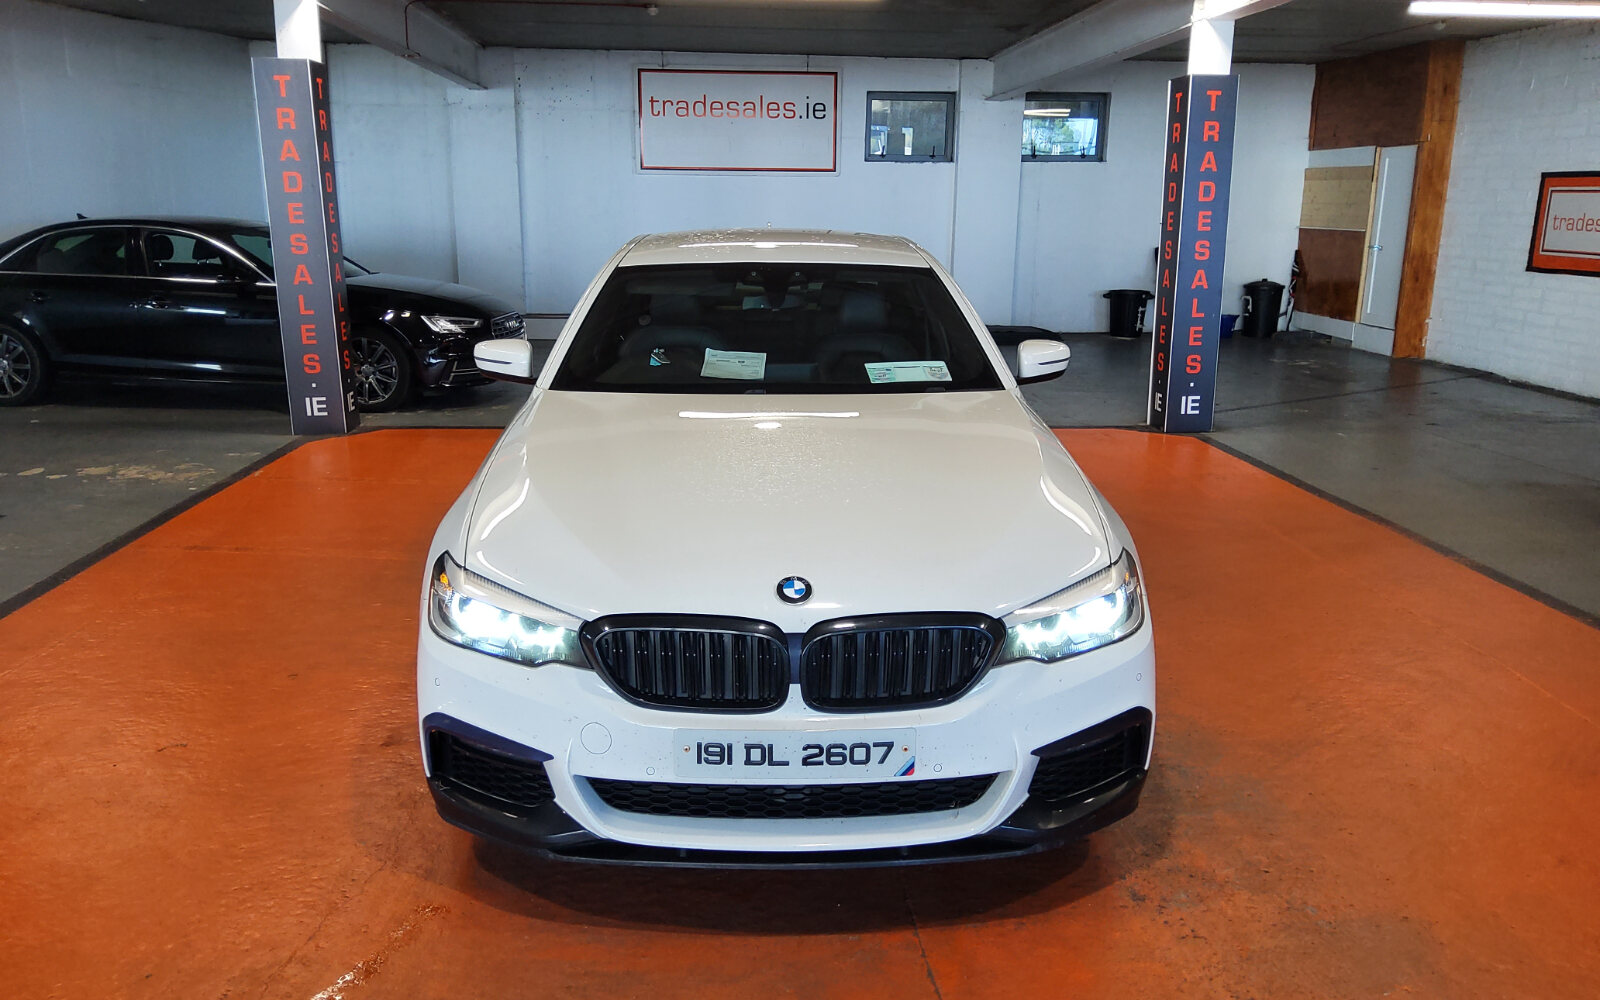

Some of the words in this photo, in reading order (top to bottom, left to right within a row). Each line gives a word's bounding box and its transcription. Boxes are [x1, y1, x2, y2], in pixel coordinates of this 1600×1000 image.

[649, 94, 827, 120] tradesales.ie
[696, 741, 732, 766] 191
[743, 743, 790, 767] DL
[801, 741, 895, 767] 2607
